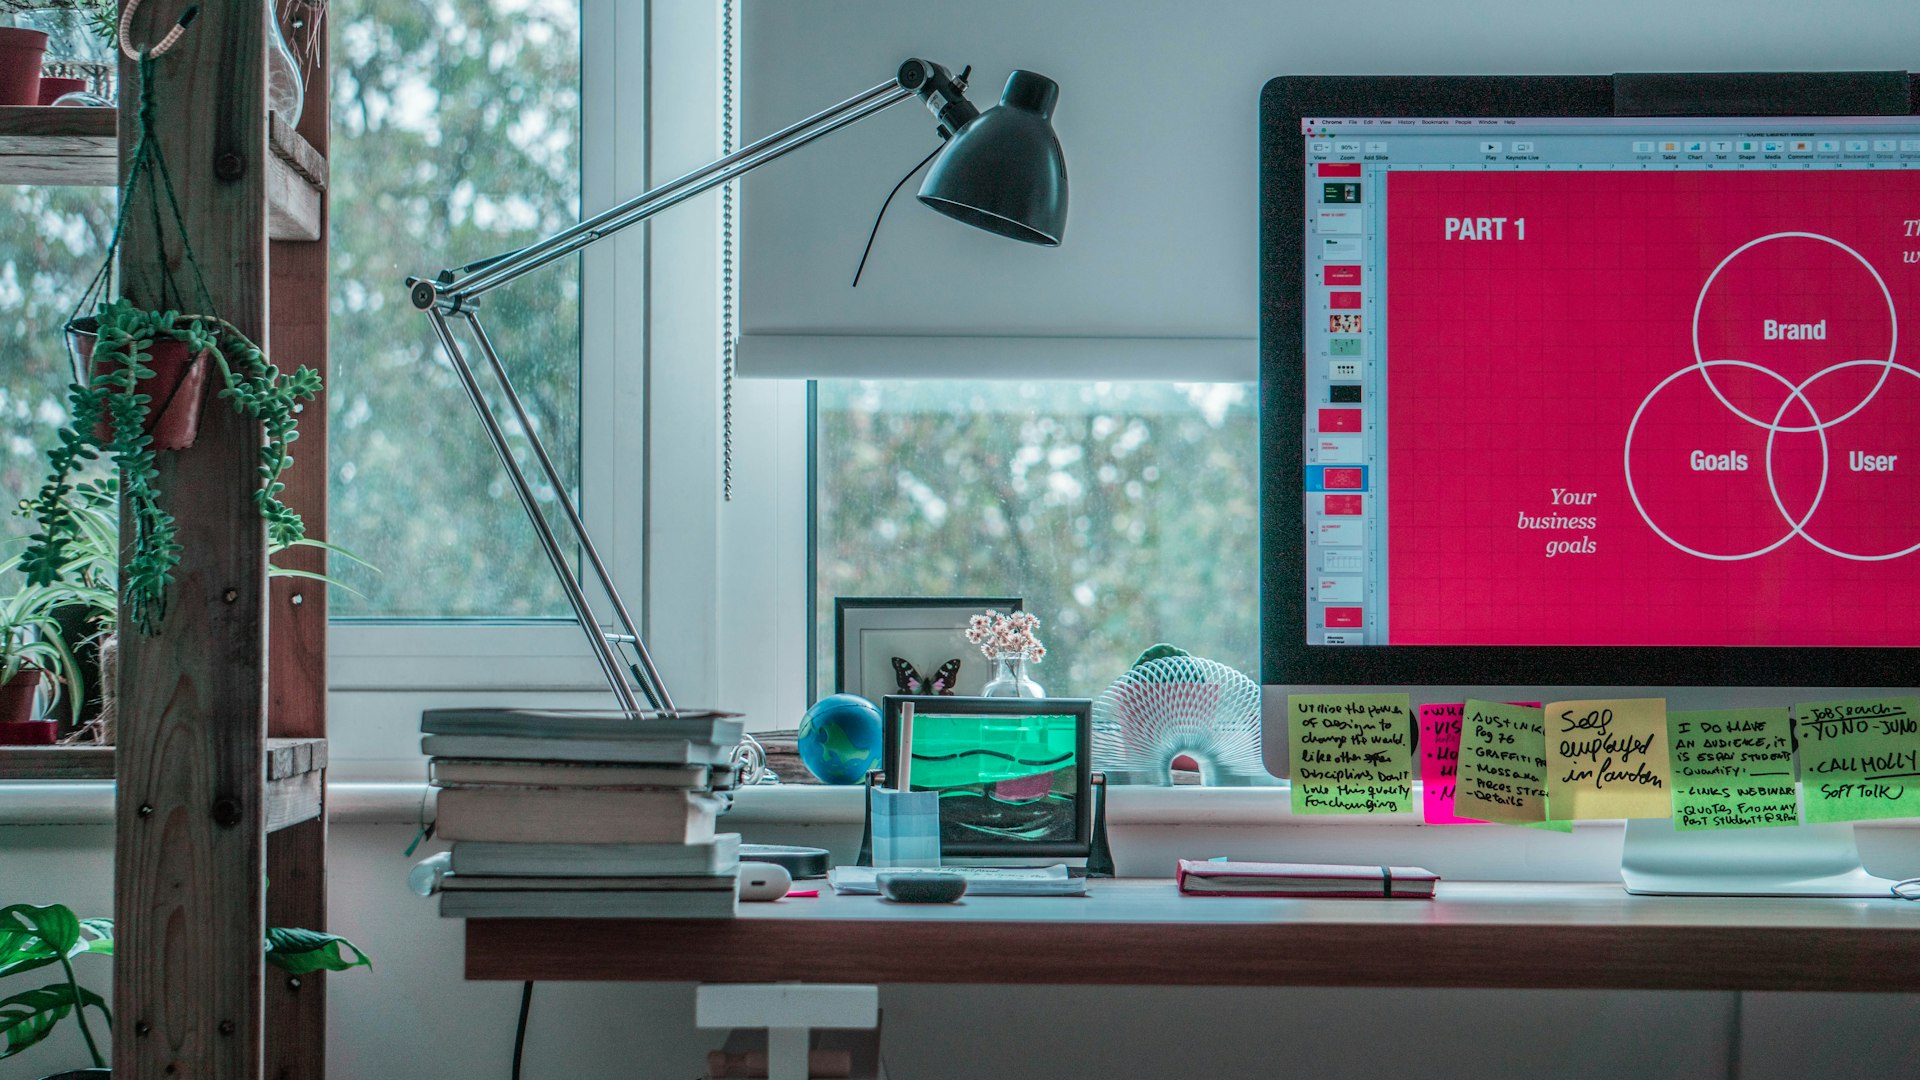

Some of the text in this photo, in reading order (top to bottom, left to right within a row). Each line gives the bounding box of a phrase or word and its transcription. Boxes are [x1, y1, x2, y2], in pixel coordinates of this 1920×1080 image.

[1445, 217, 1524, 240] PART 1
[1764, 319, 1826, 340] Brand
[1690, 450, 1748, 471] Goals
[1849, 451, 1898, 471] User
[1551, 488, 1597, 505] Your
[1517, 512, 1597, 529] business
[1546, 536, 1597, 558] goals
[1345, 702, 1364, 714] the
[1368, 705, 1403, 718] power
[1322, 719, 1376, 736] Design
[1379, 719, 1391, 731] to
[1561, 709, 1613, 736] Self
[1679, 720, 1766, 734] I DO HAVE
[1302, 732, 1346, 748] change
[1351, 734, 1368, 745] the
[1498, 733, 1514, 744] 76
[1560, 732, 1654, 762] employed
[1675, 739, 1695, 750] AN
[1302, 750, 1331, 763] like
[1335, 752, 1361, 763] other
[1476, 747, 1531, 763] GRAFFITI
[1740, 751, 1791, 761] STUDENTS
[1817, 750, 1916, 773] CALL MOLLY
[1562, 761, 1593, 782] in
[1337, 783, 1365, 795] this
[1689, 787, 1730, 798] LINKS
